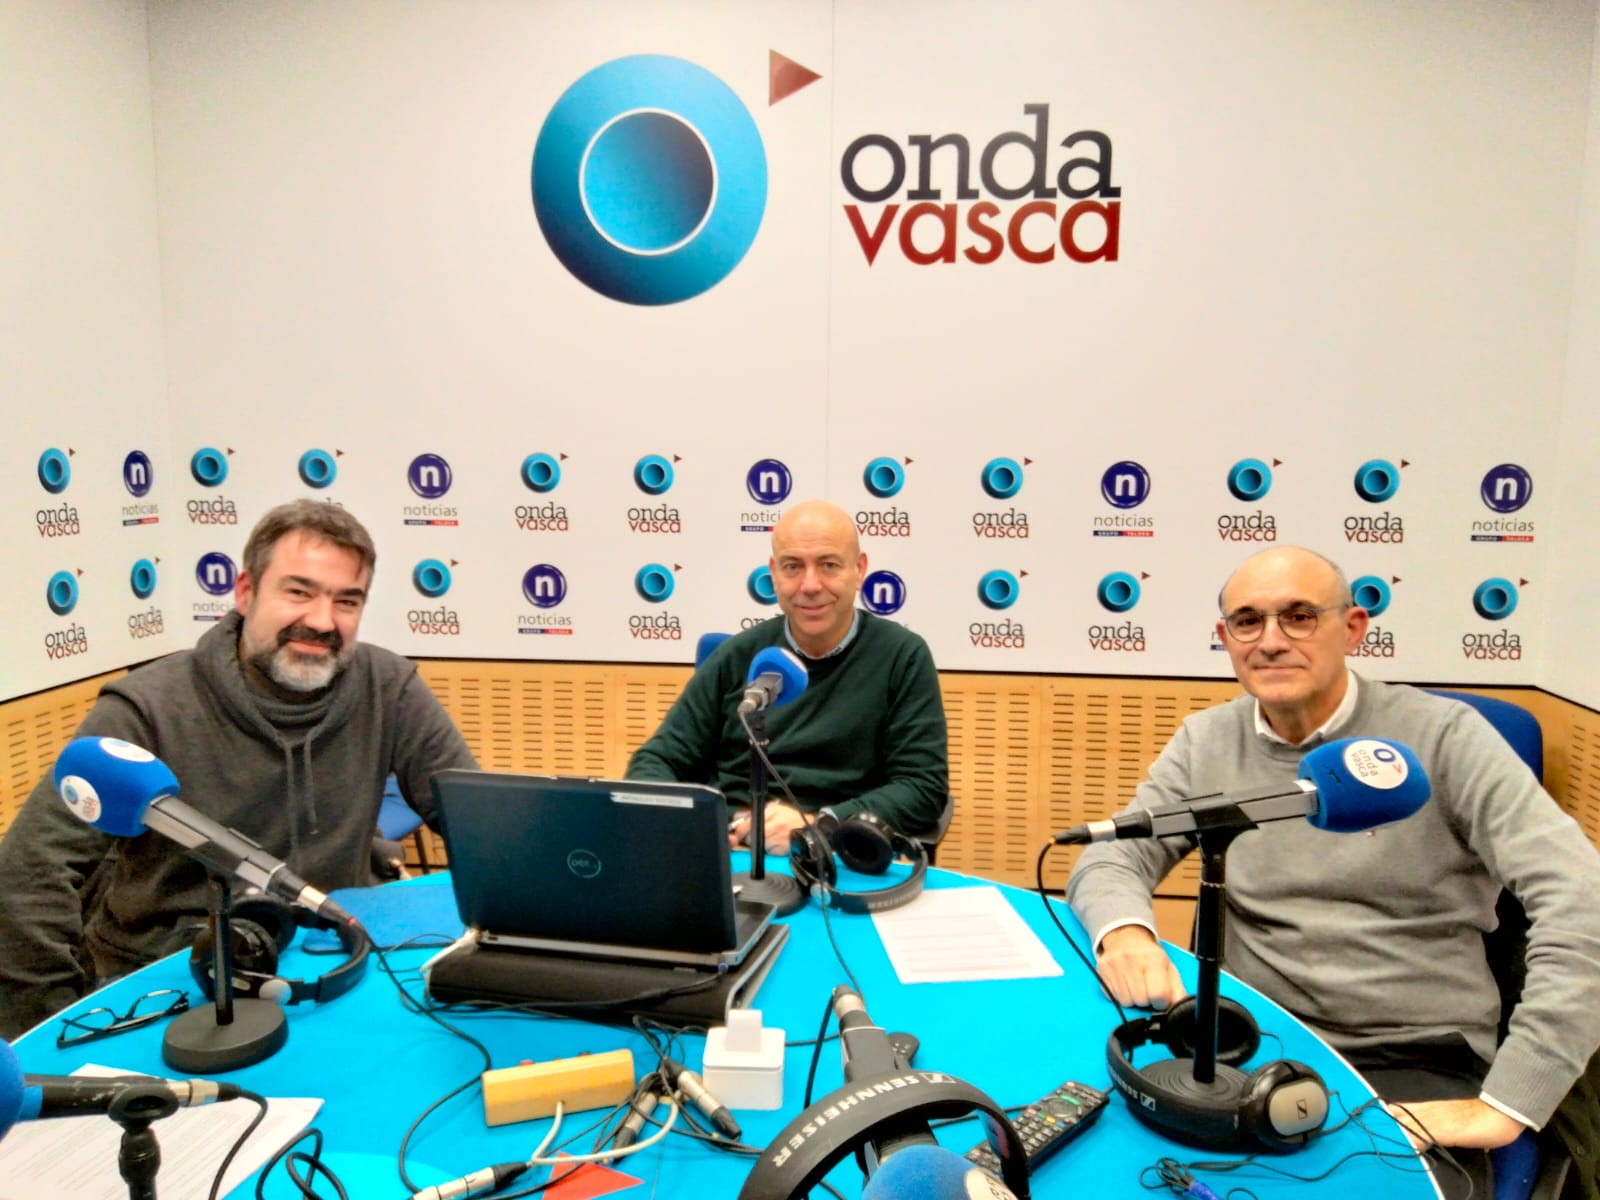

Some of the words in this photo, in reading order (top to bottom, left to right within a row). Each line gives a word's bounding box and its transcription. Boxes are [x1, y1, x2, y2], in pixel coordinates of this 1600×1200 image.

[840, 103, 1121, 203] onda
[843, 201, 1121, 267] vasca
[36, 502, 79, 525] onda
[187, 496, 236, 513] onda
[403, 504, 458, 517] noticias
[514, 501, 567, 519] onda
[627, 503, 680, 521] onda
[188, 511, 238, 525] vasca
[515, 517, 569, 531] vasca
[741, 510, 781, 523] notici
[855, 506, 911, 525] onda
[972, 508, 1028, 526] onda
[1094, 514, 1154, 527] noticias
[1217, 510, 1276, 529] onda
[1344, 512, 1404, 531] onda
[1472, 517, 1535, 532] noticias
[38, 519, 80, 539] vasca
[628, 519, 681, 533] vasca
[856, 523, 911, 537] vasca
[973, 524, 1029, 538] vasca
[1219, 526, 1277, 541] vasca
[1344, 528, 1404, 544] vasca
[128, 606, 162, 628] onda
[407, 606, 459, 624] onda
[518, 613, 572, 626] noticias
[628, 611, 681, 629] onda
[45, 622, 87, 648] onda
[408, 622, 461, 636] vasca
[630, 626, 683, 641] vasca
[969, 618, 1024, 636] onda
[1088, 621, 1145, 640] onda
[970, 634, 1025, 648] vasca
[1089, 637, 1146, 652] vasca
[1462, 629, 1521, 649] onda
[46, 638, 88, 660] vasca
[1463, 645, 1522, 660] vasca
[772, 1074, 921, 1168] SENNHEISER
